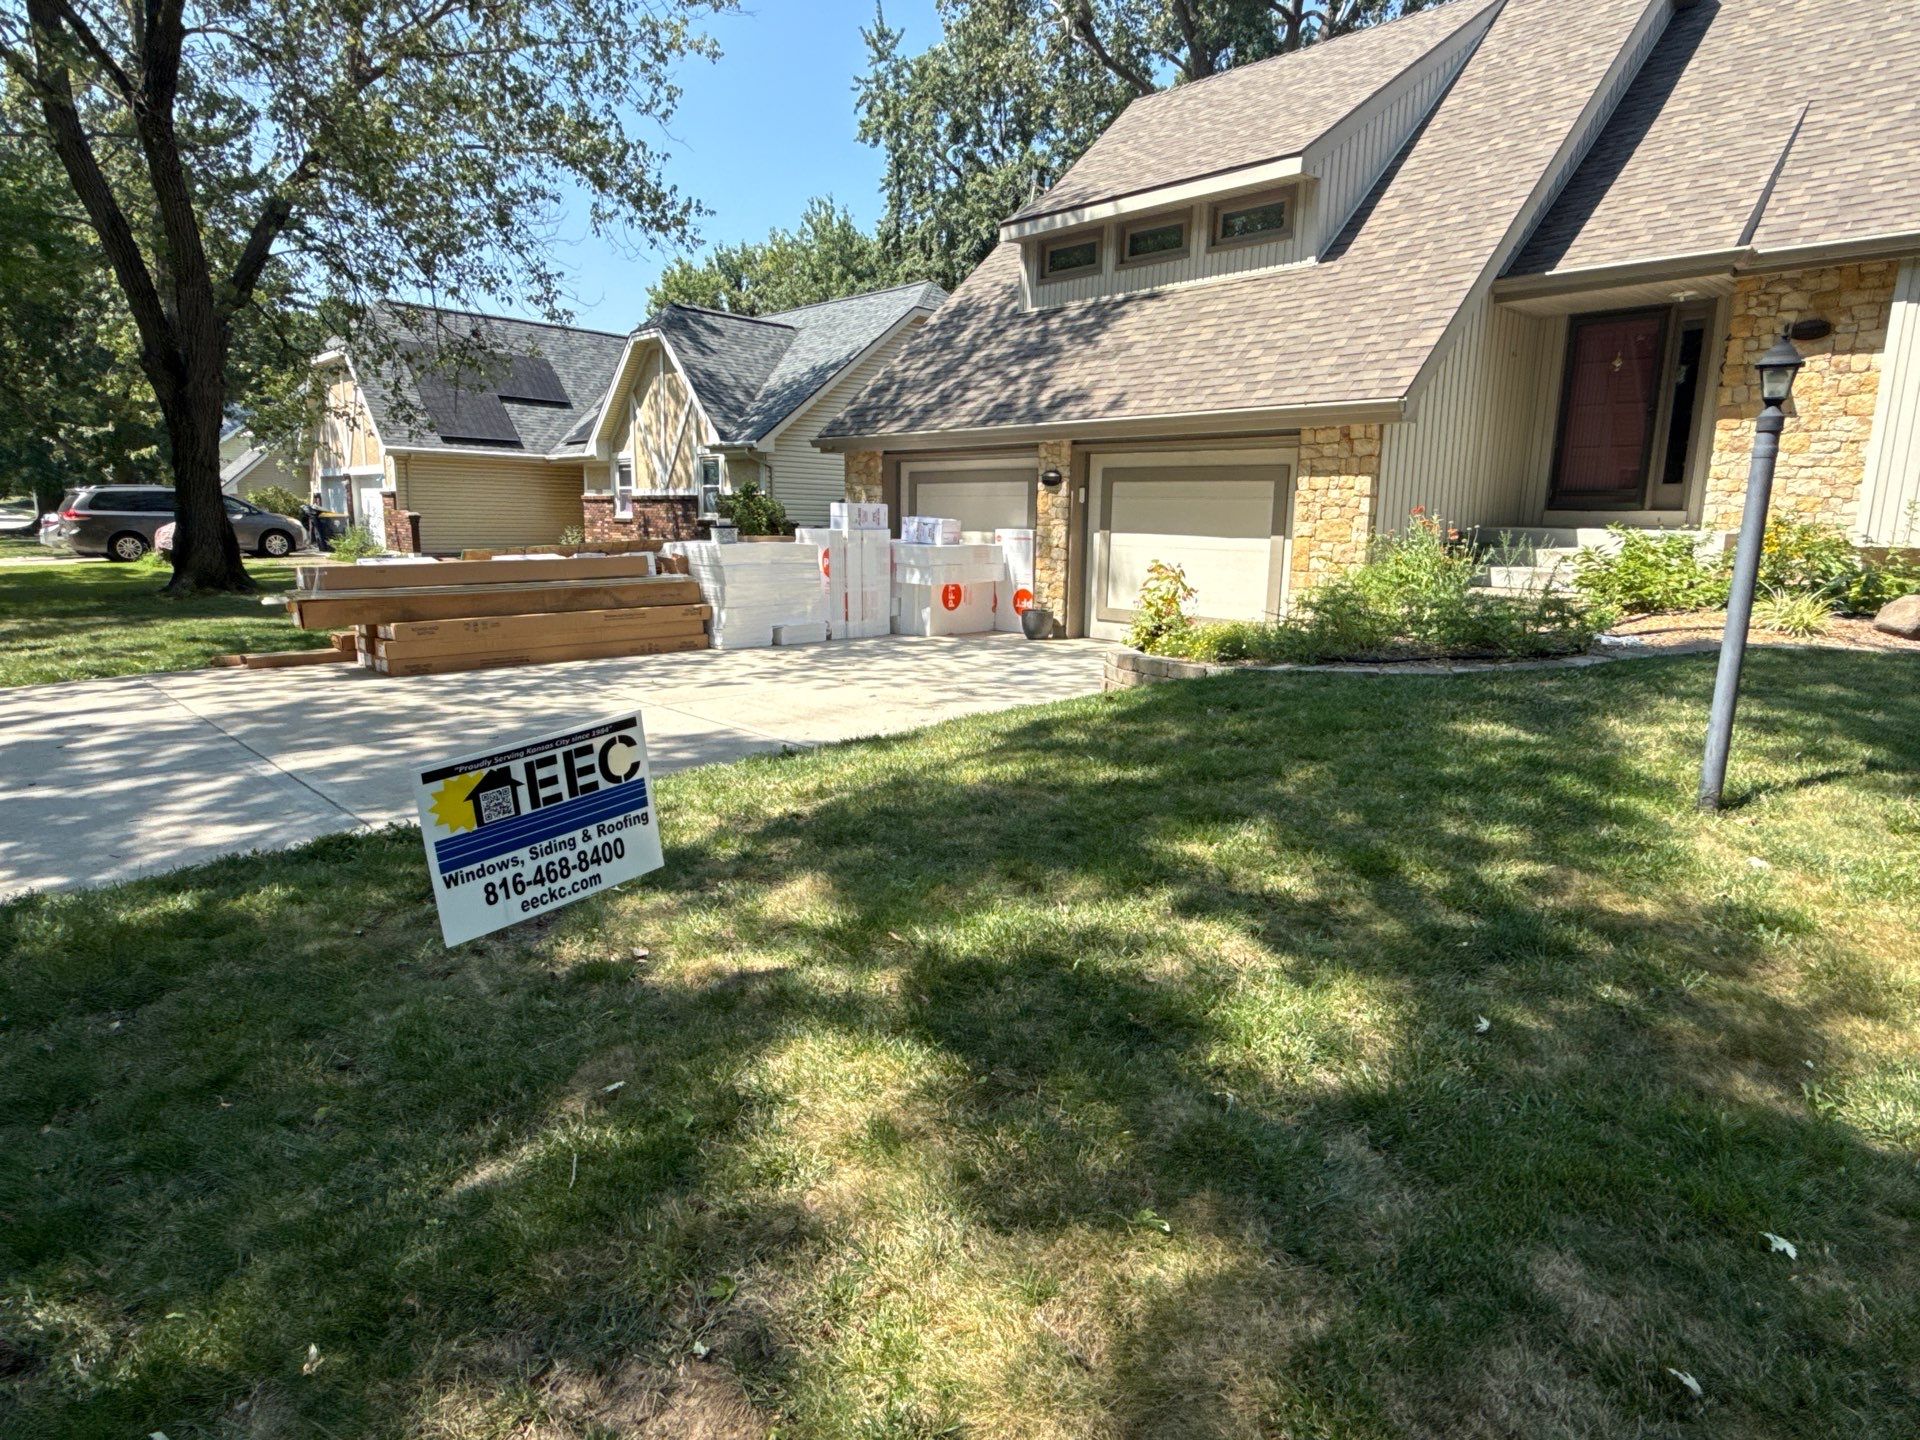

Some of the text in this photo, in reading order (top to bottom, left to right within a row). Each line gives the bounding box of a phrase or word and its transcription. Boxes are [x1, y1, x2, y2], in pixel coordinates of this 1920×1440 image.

[493, 751, 525, 764] Serving
[526, 743, 554, 755] Kansas
[555, 736, 571, 747] City
[571, 732, 591, 742] since
[524, 734, 640, 810] EEC
[442, 811, 650, 890] Windows, Siding & Roofing
[483, 837, 626, 906] 816-468-8400
[520, 872, 602, 913] eeckc.com
